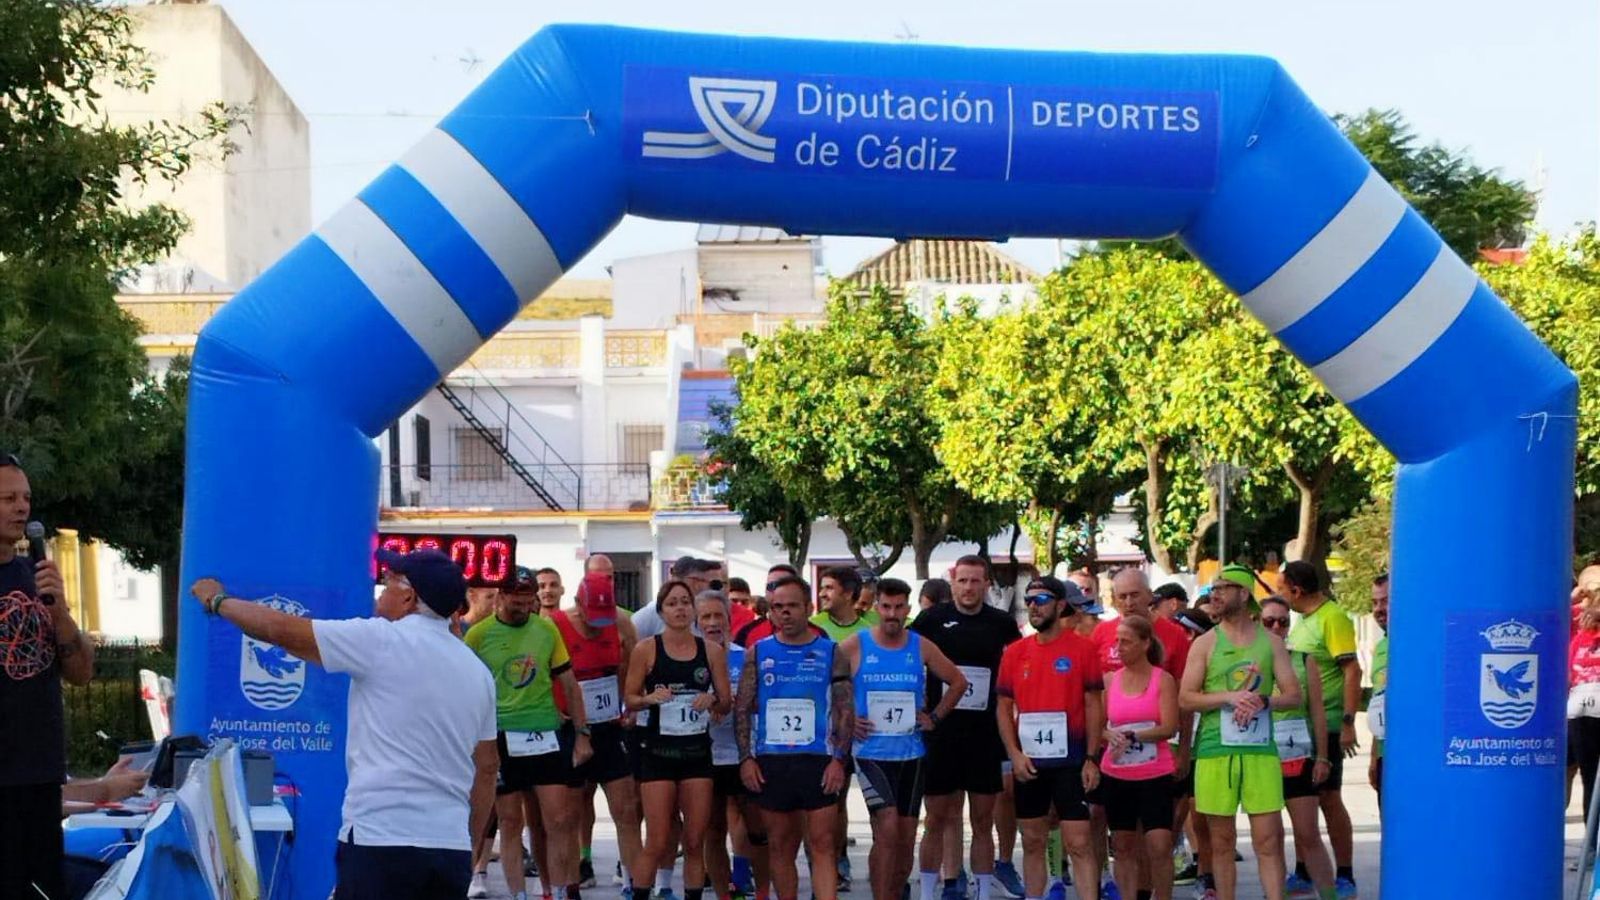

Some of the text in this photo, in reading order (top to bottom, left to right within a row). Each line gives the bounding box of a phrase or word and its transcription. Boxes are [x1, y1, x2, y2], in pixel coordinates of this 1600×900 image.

[797, 83, 994, 124] Diputación
[1031, 101, 1200, 134] DEPORTES
[796, 132, 957, 172] de Cádiz
[594, 693, 611, 711] 20
[680, 707, 699, 722] 16
[882, 708, 904, 724] 47
[209, 716, 331, 735] Ayuntamiento de
[781, 715, 802, 731] 32
[272, 736, 296, 750] del
[300, 737, 333, 751] Valle
[1033, 730, 1054, 745] 44
[1449, 736, 1556, 751] Ayuntamiento de
[1446, 752, 1557, 767] San José del Valle
